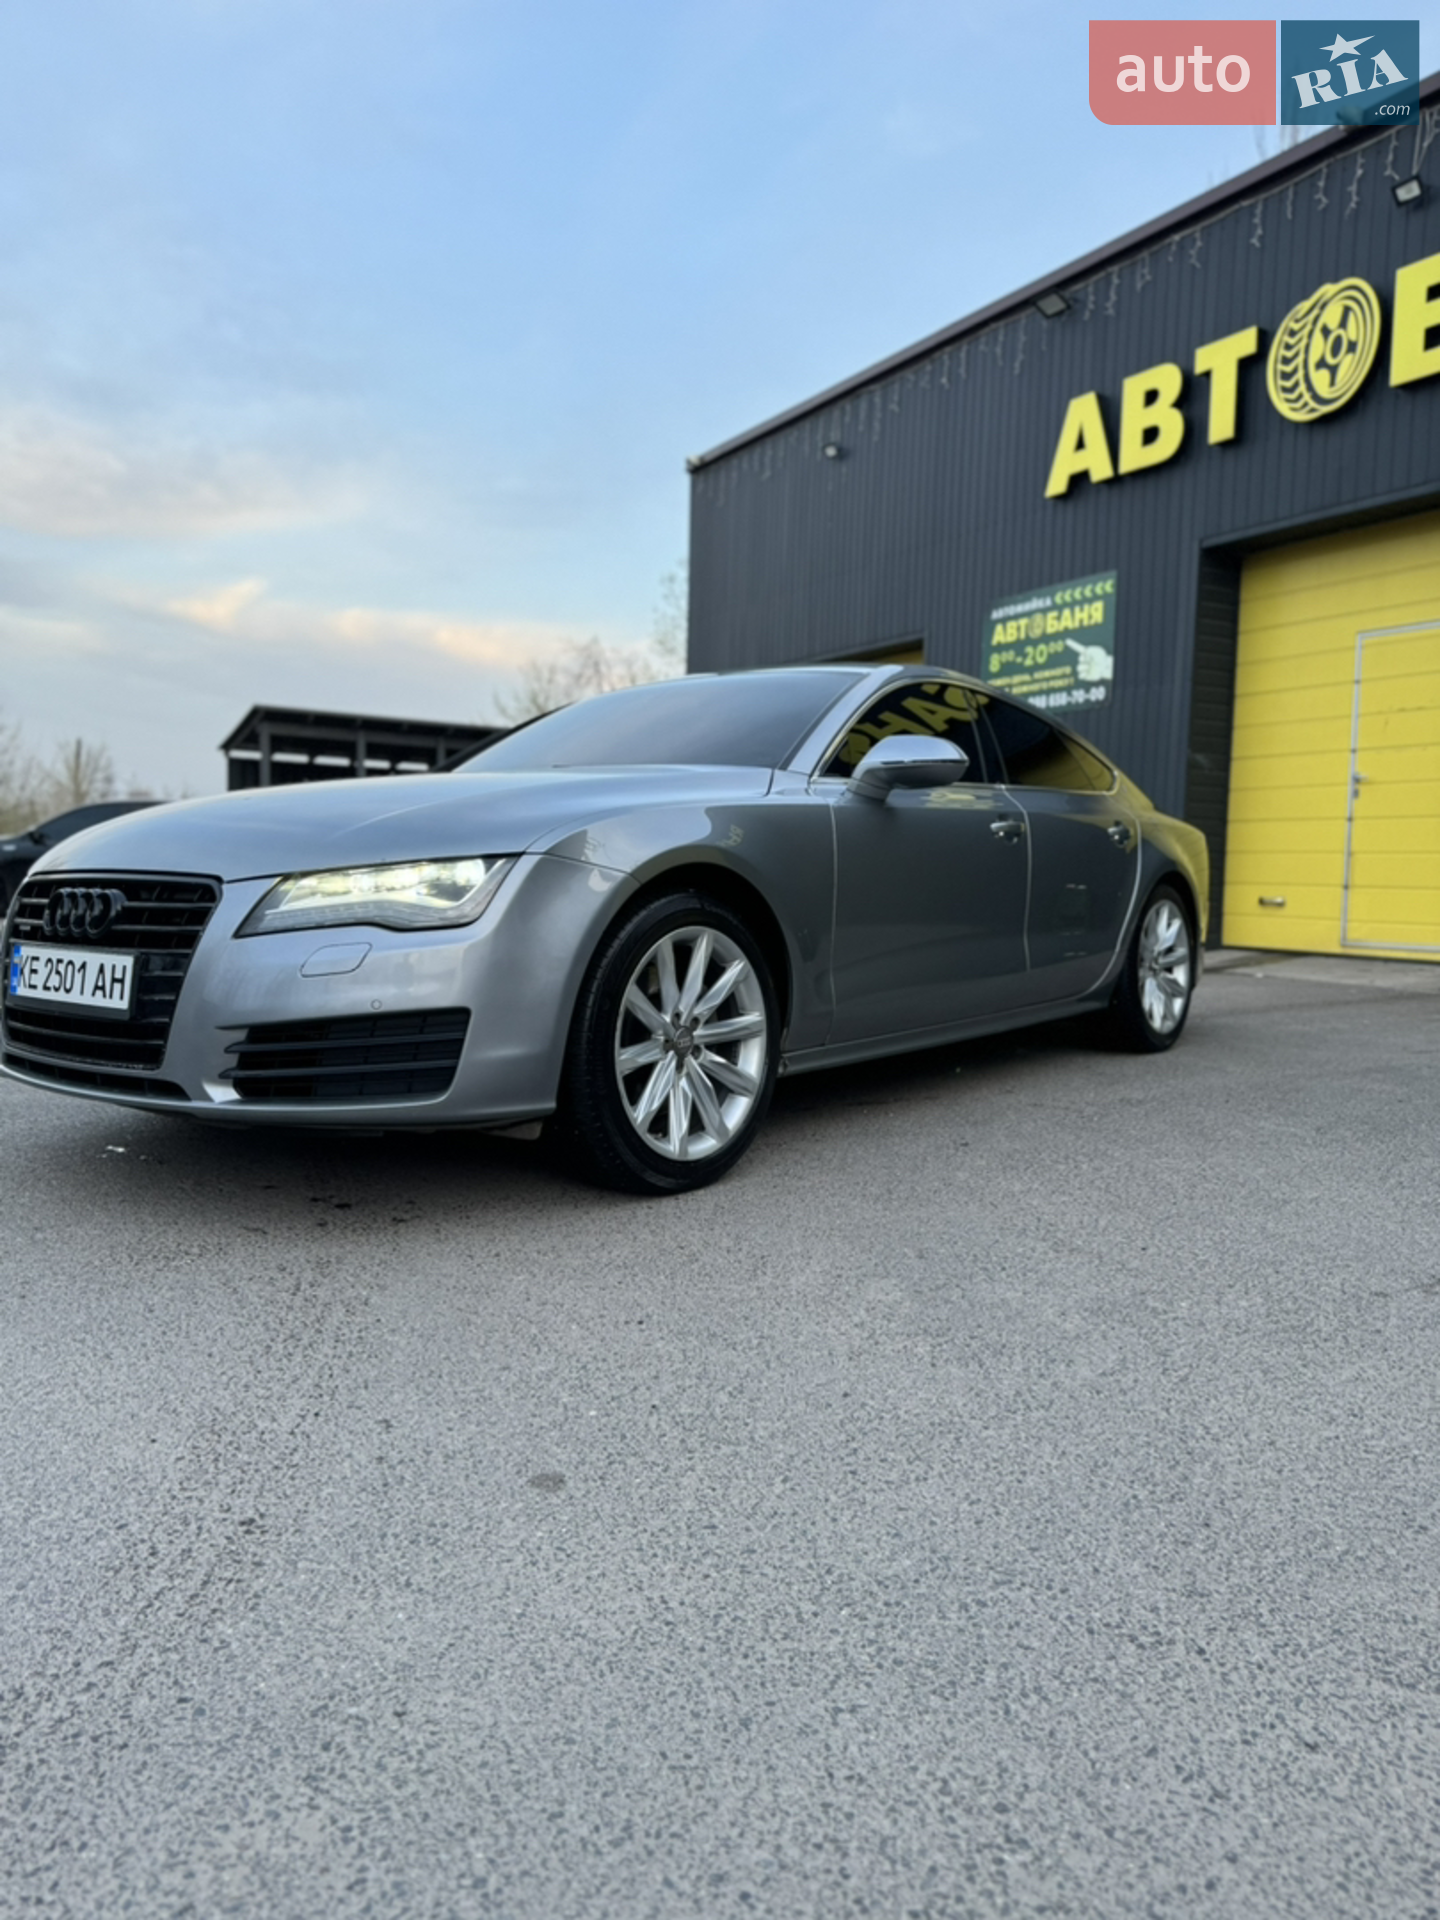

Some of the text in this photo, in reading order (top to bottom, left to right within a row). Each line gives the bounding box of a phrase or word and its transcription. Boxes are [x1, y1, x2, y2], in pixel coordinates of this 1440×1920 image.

[18, 954, 127, 1001] KE 2501 AH
